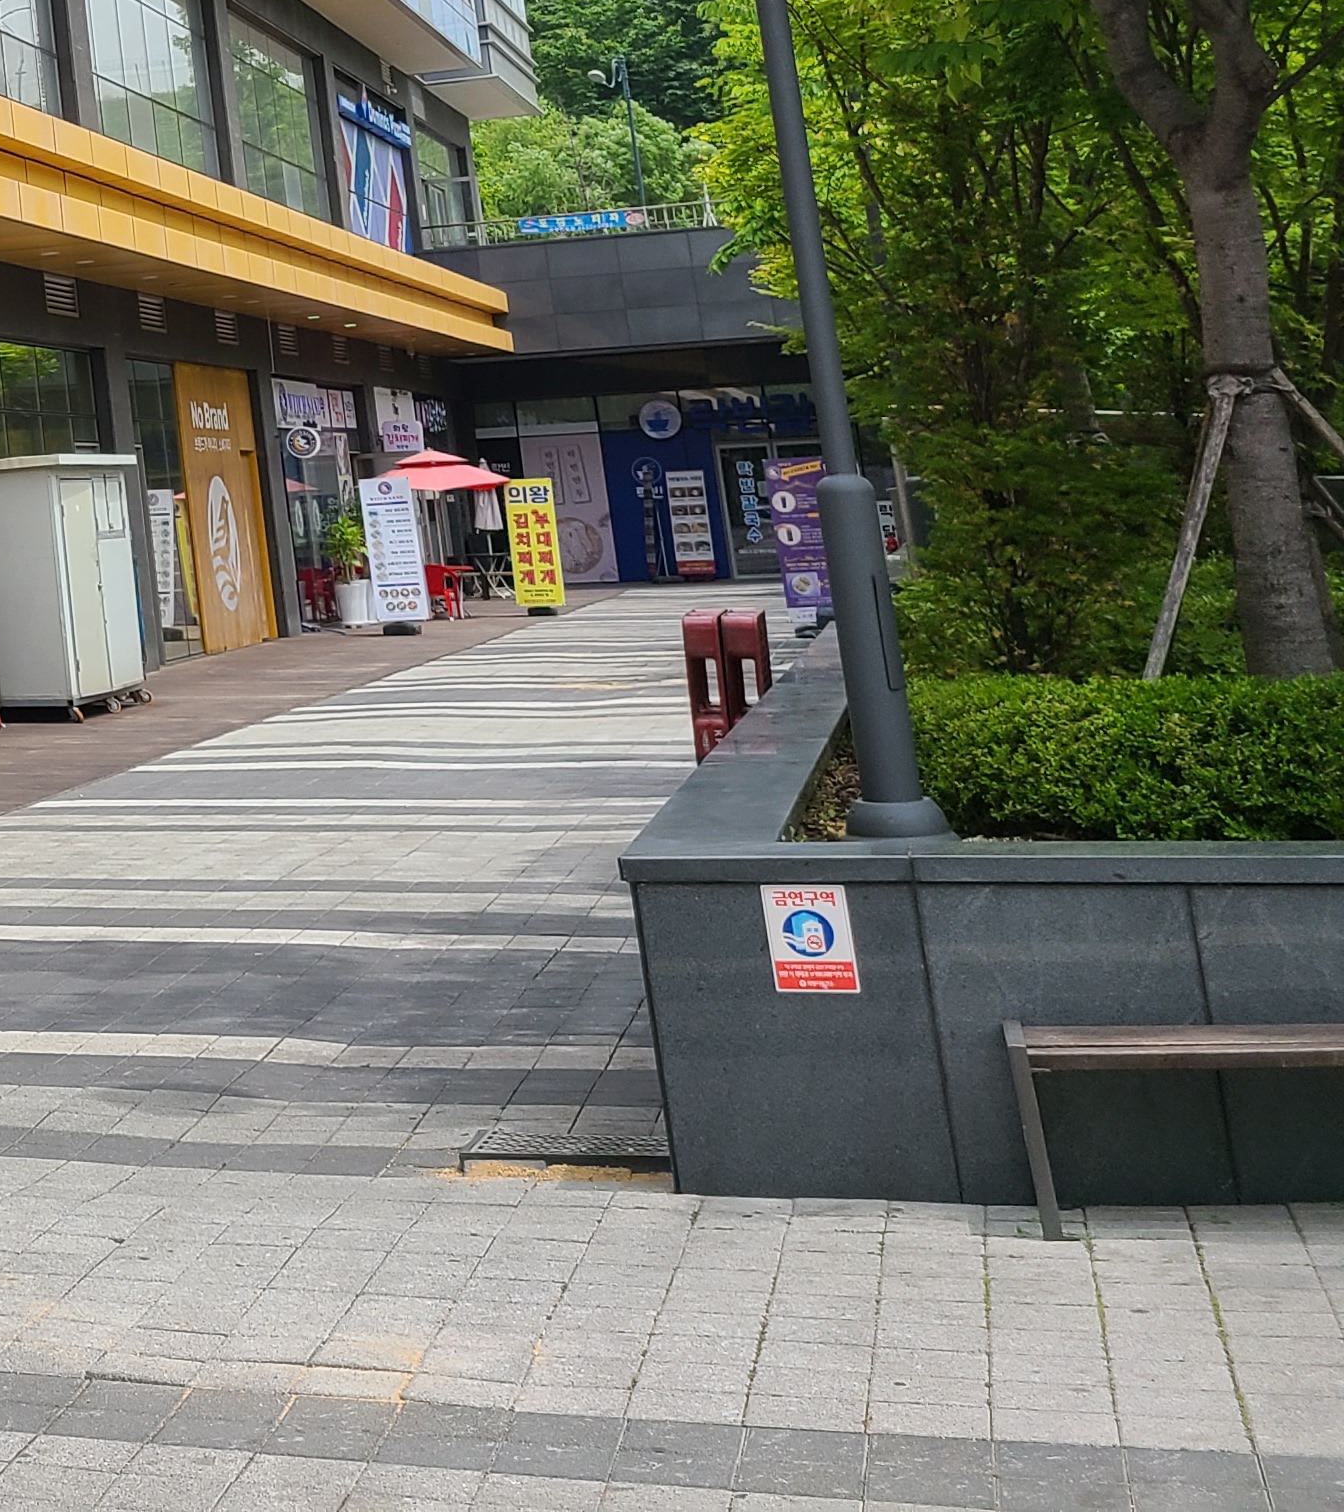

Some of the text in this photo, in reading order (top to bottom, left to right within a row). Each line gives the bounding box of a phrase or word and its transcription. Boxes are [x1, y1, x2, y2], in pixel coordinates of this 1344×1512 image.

[190, 401, 229, 430] No Brand
[508, 486, 549, 504] 의왕
